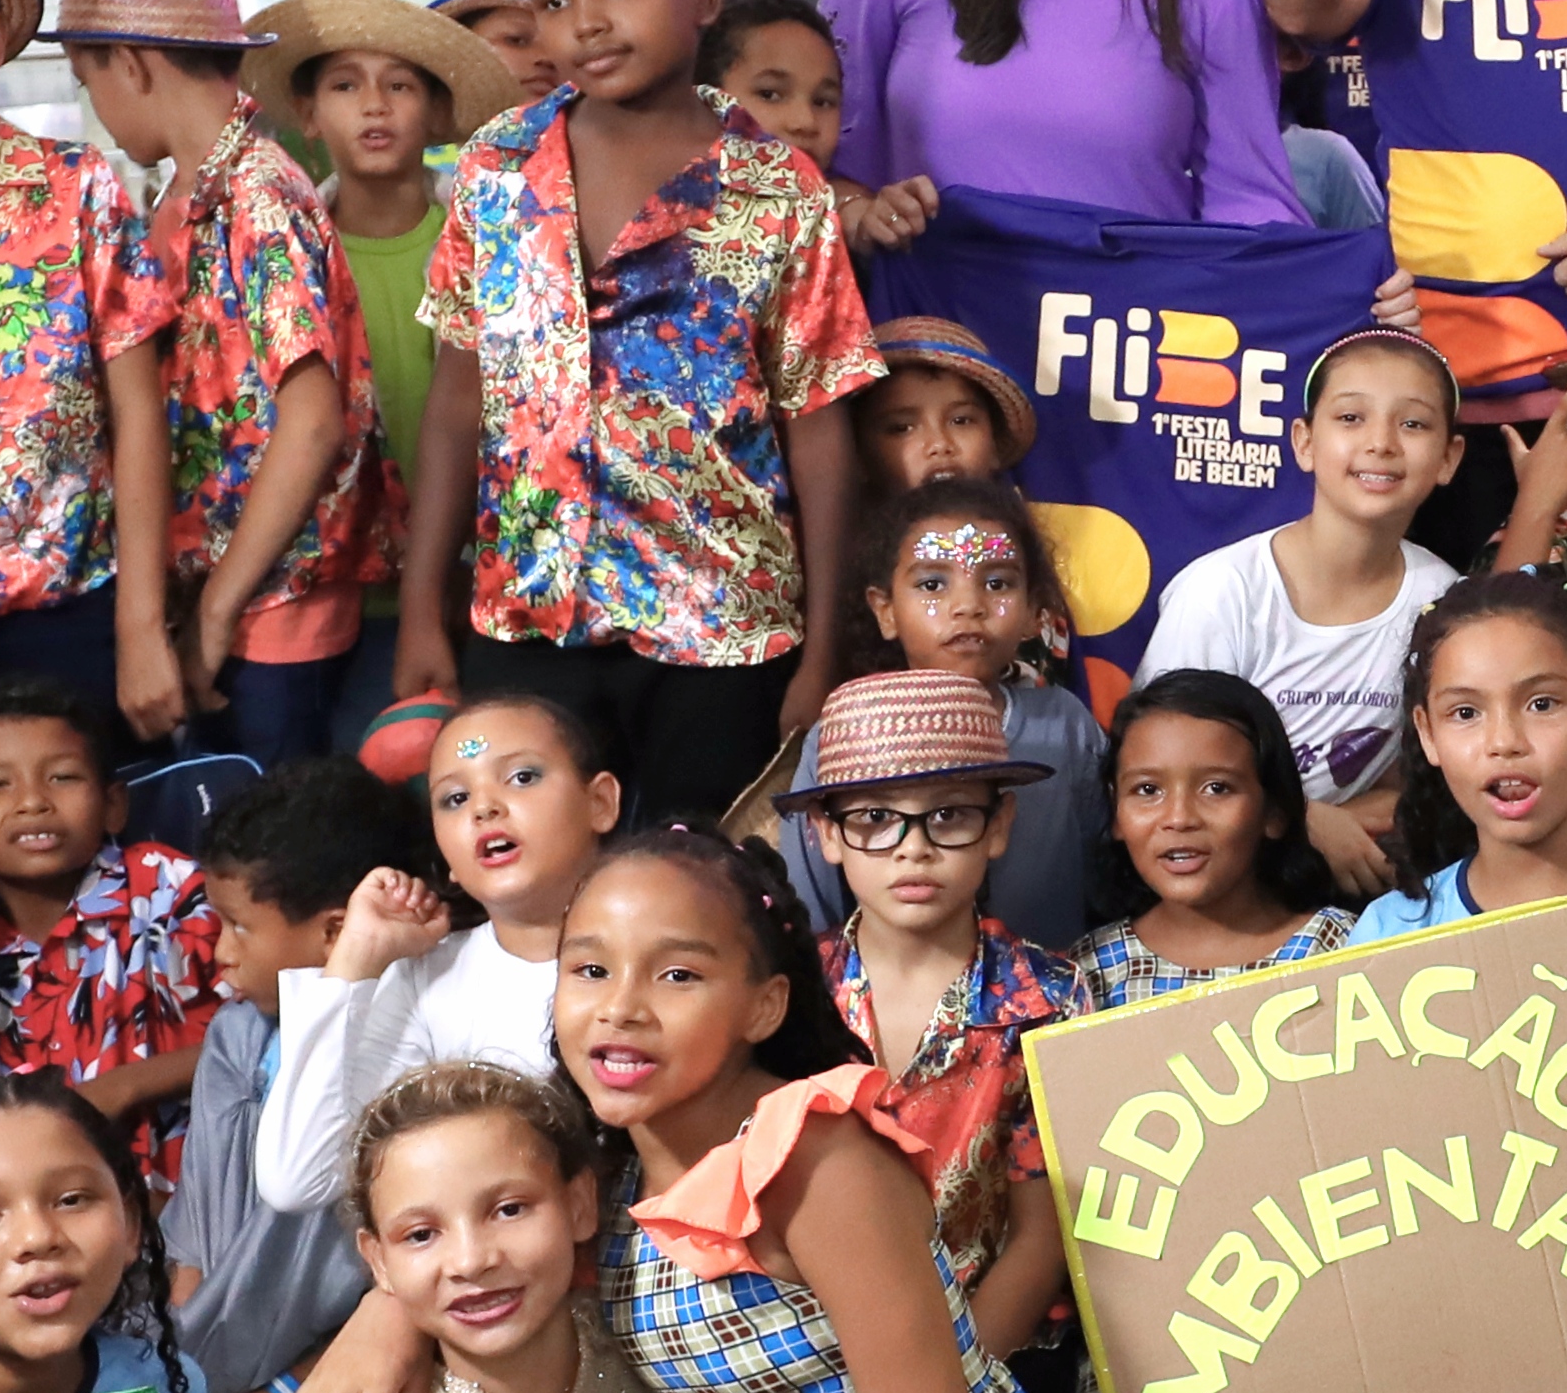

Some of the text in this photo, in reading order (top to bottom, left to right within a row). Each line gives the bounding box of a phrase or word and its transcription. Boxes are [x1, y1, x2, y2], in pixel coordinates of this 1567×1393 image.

[1171, 415, 1230, 441] FESTA
[1176, 436, 1282, 467] LITERÁRIA
[1175, 461, 1275, 488] DE BELÉM
[1277, 686, 1399, 709] GRUPO FOLCLÓRICO
